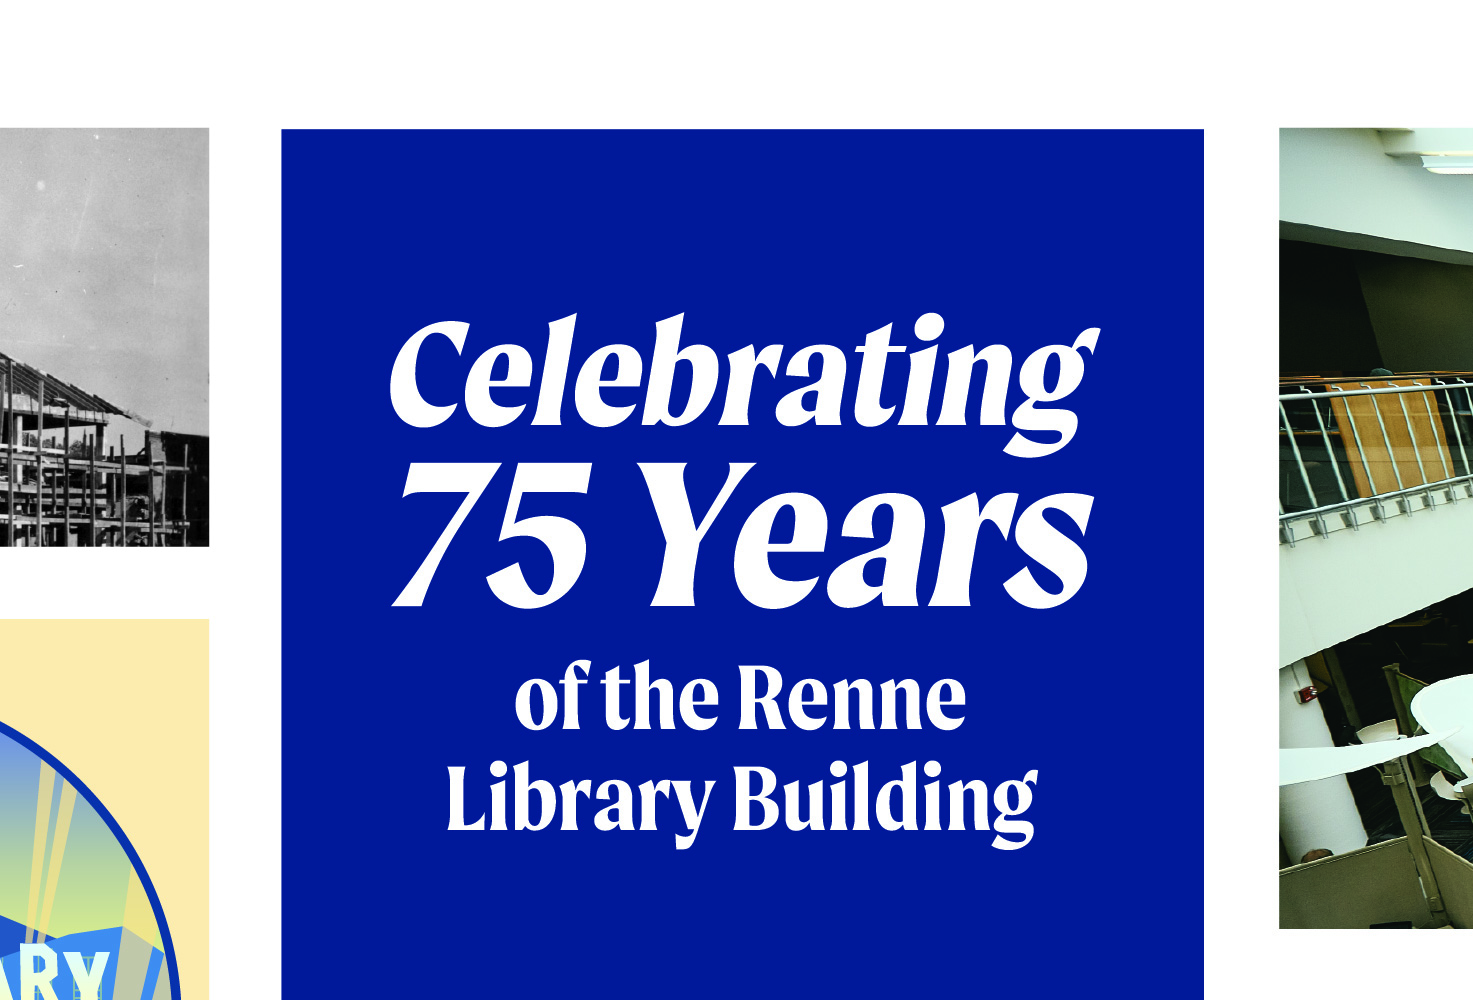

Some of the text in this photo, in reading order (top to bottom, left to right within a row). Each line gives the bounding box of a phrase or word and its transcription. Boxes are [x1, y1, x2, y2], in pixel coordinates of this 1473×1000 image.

[390, 312, 1101, 458] Celebrating
[392, 463, 1094, 609] 75 Years
[516, 659, 965, 730] of the Renne
[448, 760, 1038, 850] Library Building
